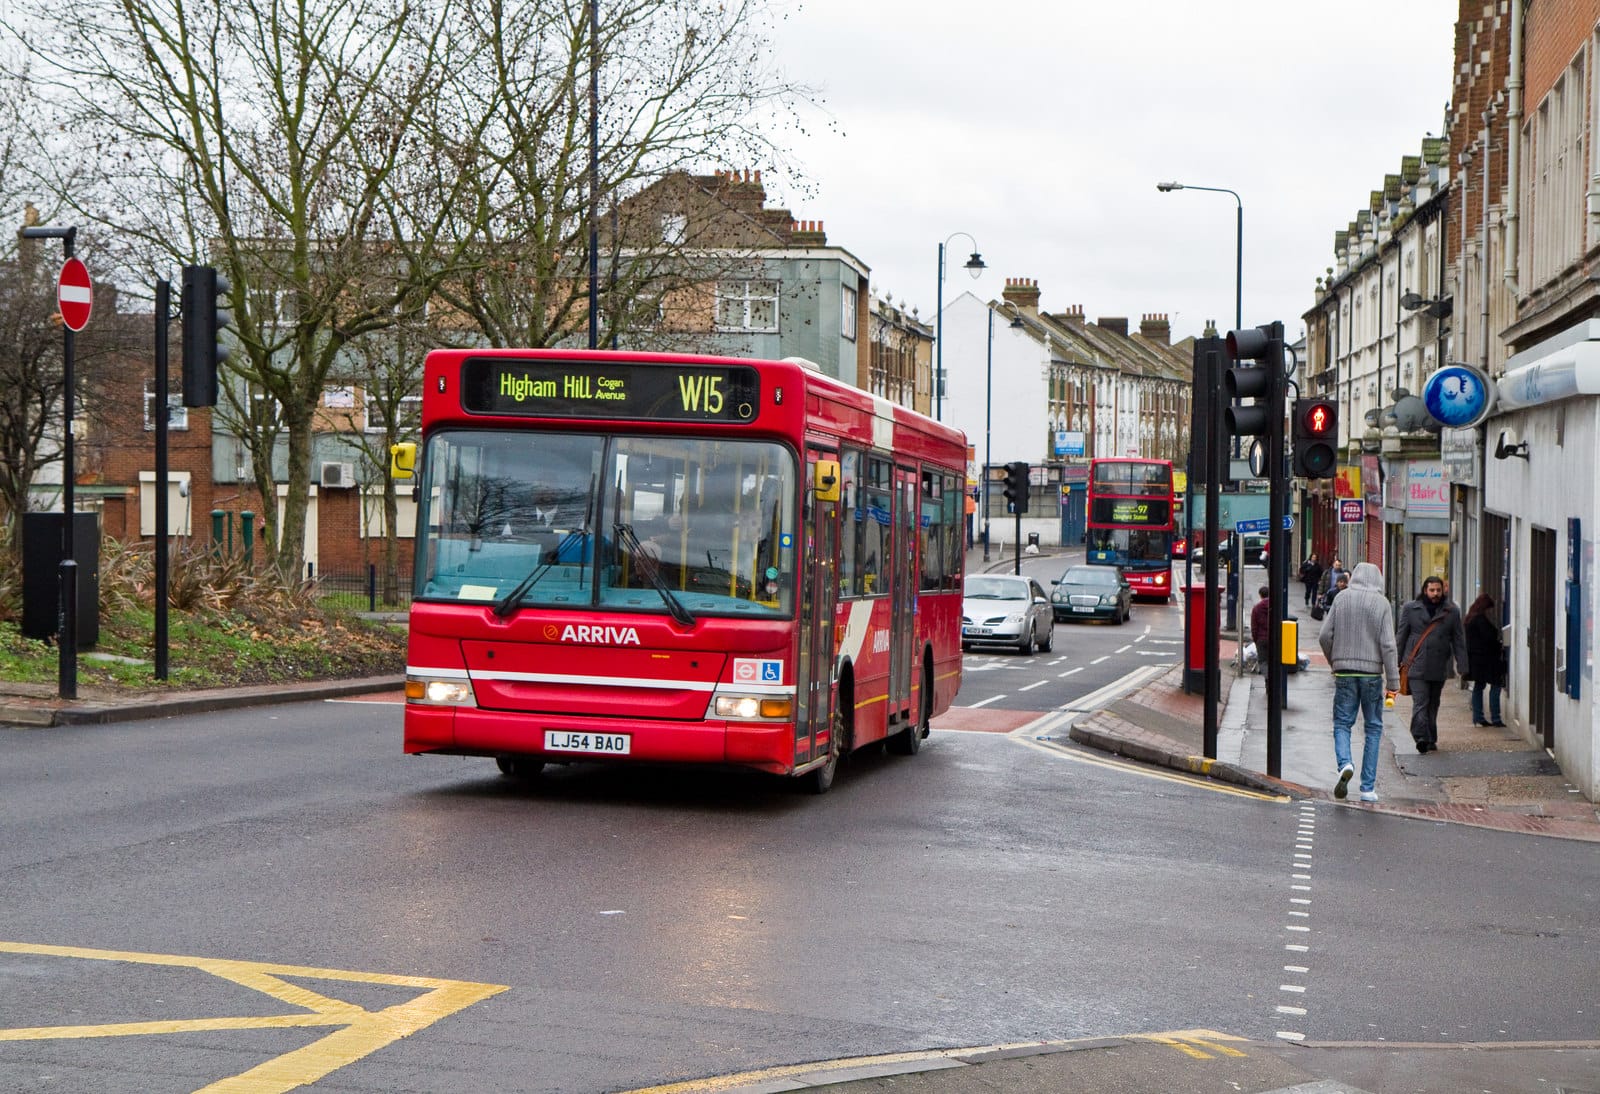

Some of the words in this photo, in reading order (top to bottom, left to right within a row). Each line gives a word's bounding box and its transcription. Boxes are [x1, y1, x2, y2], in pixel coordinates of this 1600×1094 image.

[500, 373, 556, 402] Higham
[564, 375, 593, 398] Hill
[597, 376, 624, 390] Cogan
[595, 389, 626, 400] Avenue
[678, 375, 724, 413] W15
[1410, 483, 1437, 499] Hair
[1138, 505, 1148, 514] 97
[560, 624, 641, 645] ARRIVA
[551, 733, 590, 749] LJ54
[594, 735, 625, 751] BAO
